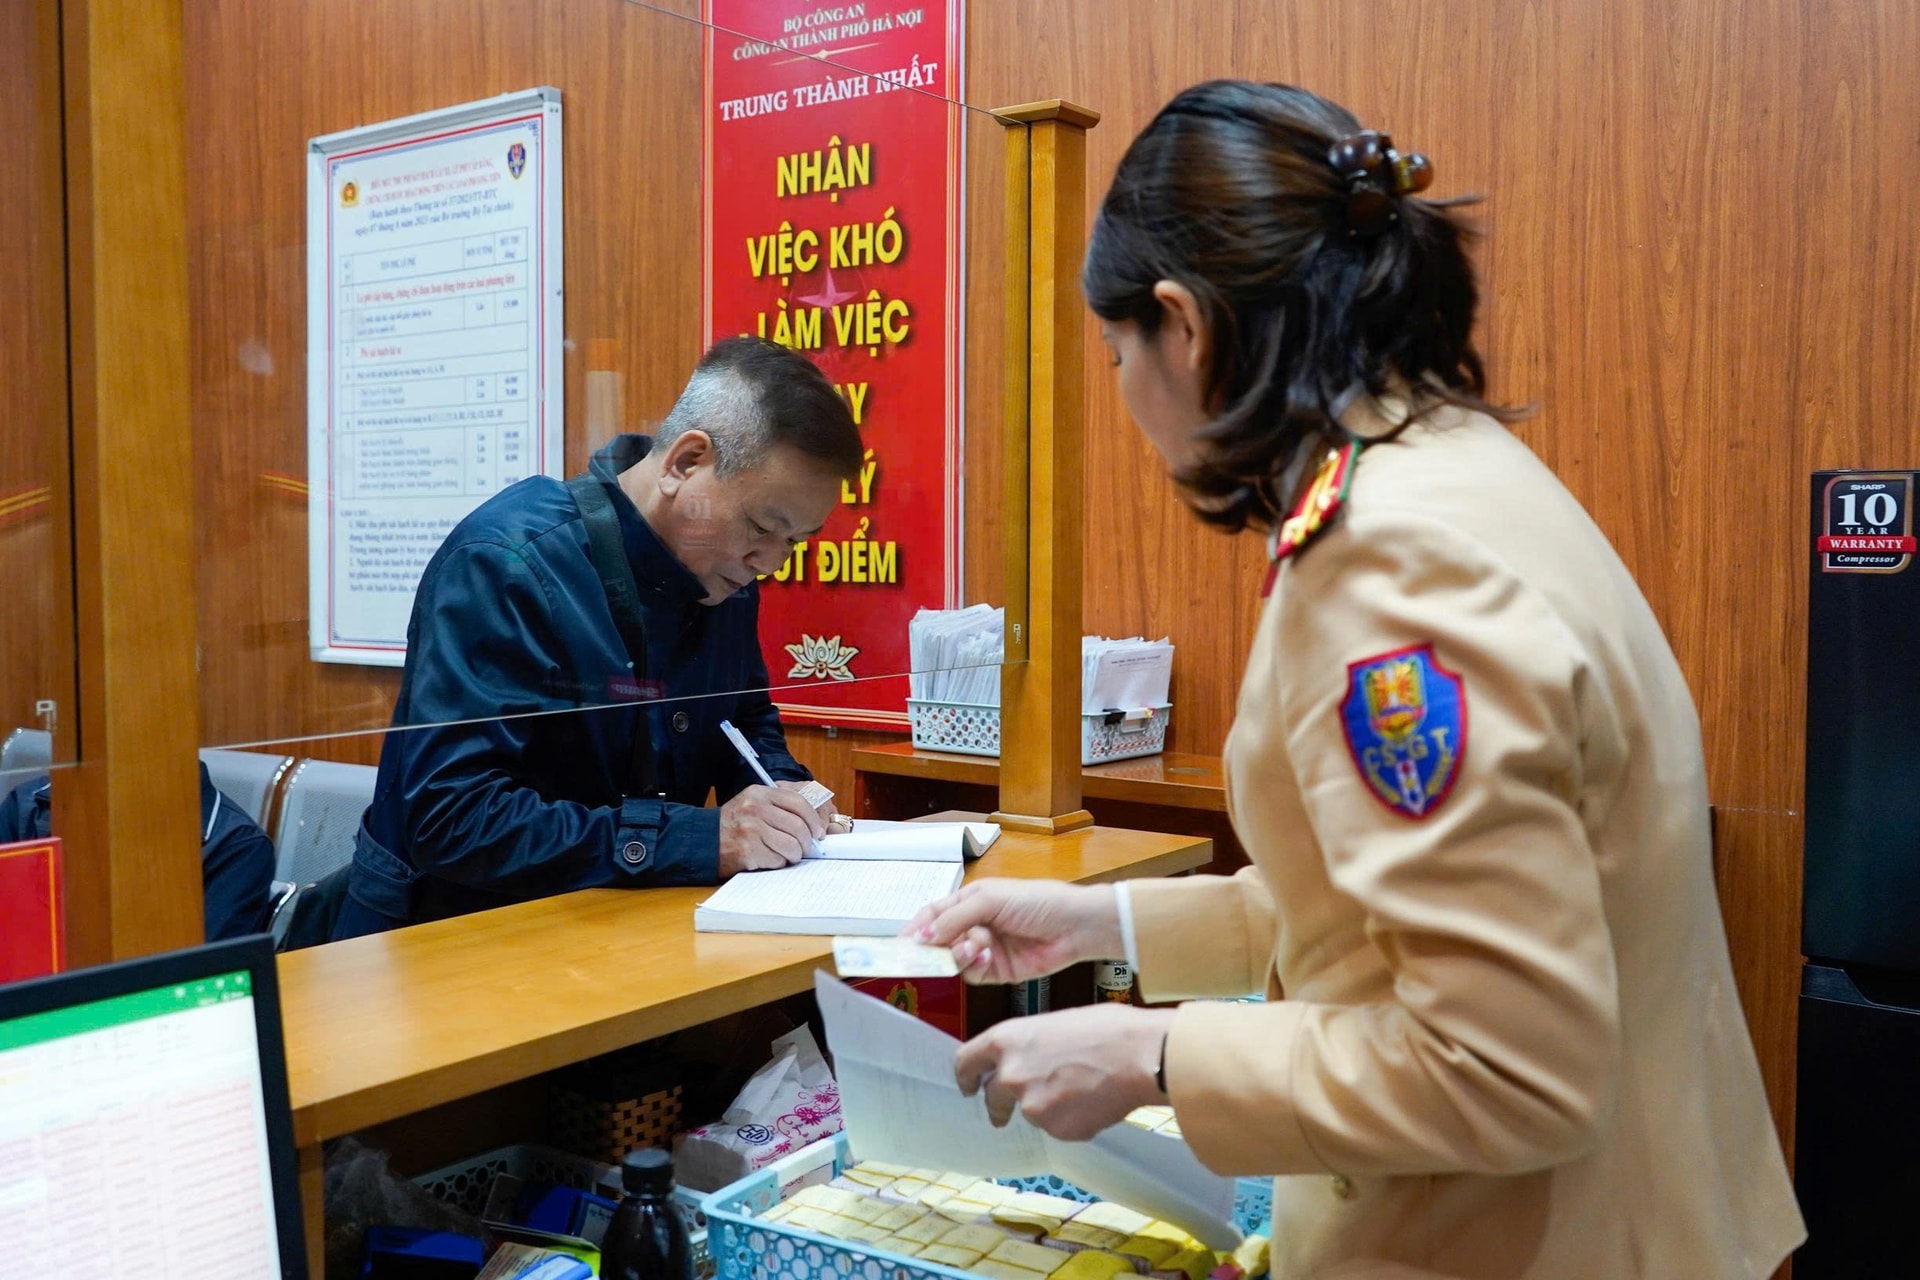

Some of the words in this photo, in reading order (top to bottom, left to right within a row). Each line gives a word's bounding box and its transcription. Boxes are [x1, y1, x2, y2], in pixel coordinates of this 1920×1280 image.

[732, 41, 770, 61] CÔNG
[770, 37, 789, 52] AN
[791, 26, 838, 49] THÀNH
[872, 13, 893, 33] HÀ
[895, 9, 925, 29] NỘI
[784, 15, 803, 33] BỘ
[804, 7, 843, 28] CÔNG
[845, 3, 865, 20] AN
[719, 90, 788, 121] TRUNG
[793, 75, 869, 108] THÀNH
[875, 54, 938, 94] NHẤT
[776, 134, 871, 203] NHẬN
[746, 220, 819, 287] VIỆC
[829, 206, 904, 269] KHÓ
[832, 289, 910, 357] VIỆC
[1838, 493, 1898, 526] 10
[1845, 527, 1889, 535] YEAR
[816, 516, 897, 583] ĐIỂM
[1830, 539, 1904, 549] WARRANTY
[1837, 554, 1896, 565] Compressor
[1362, 727, 1449, 770] CSGT
